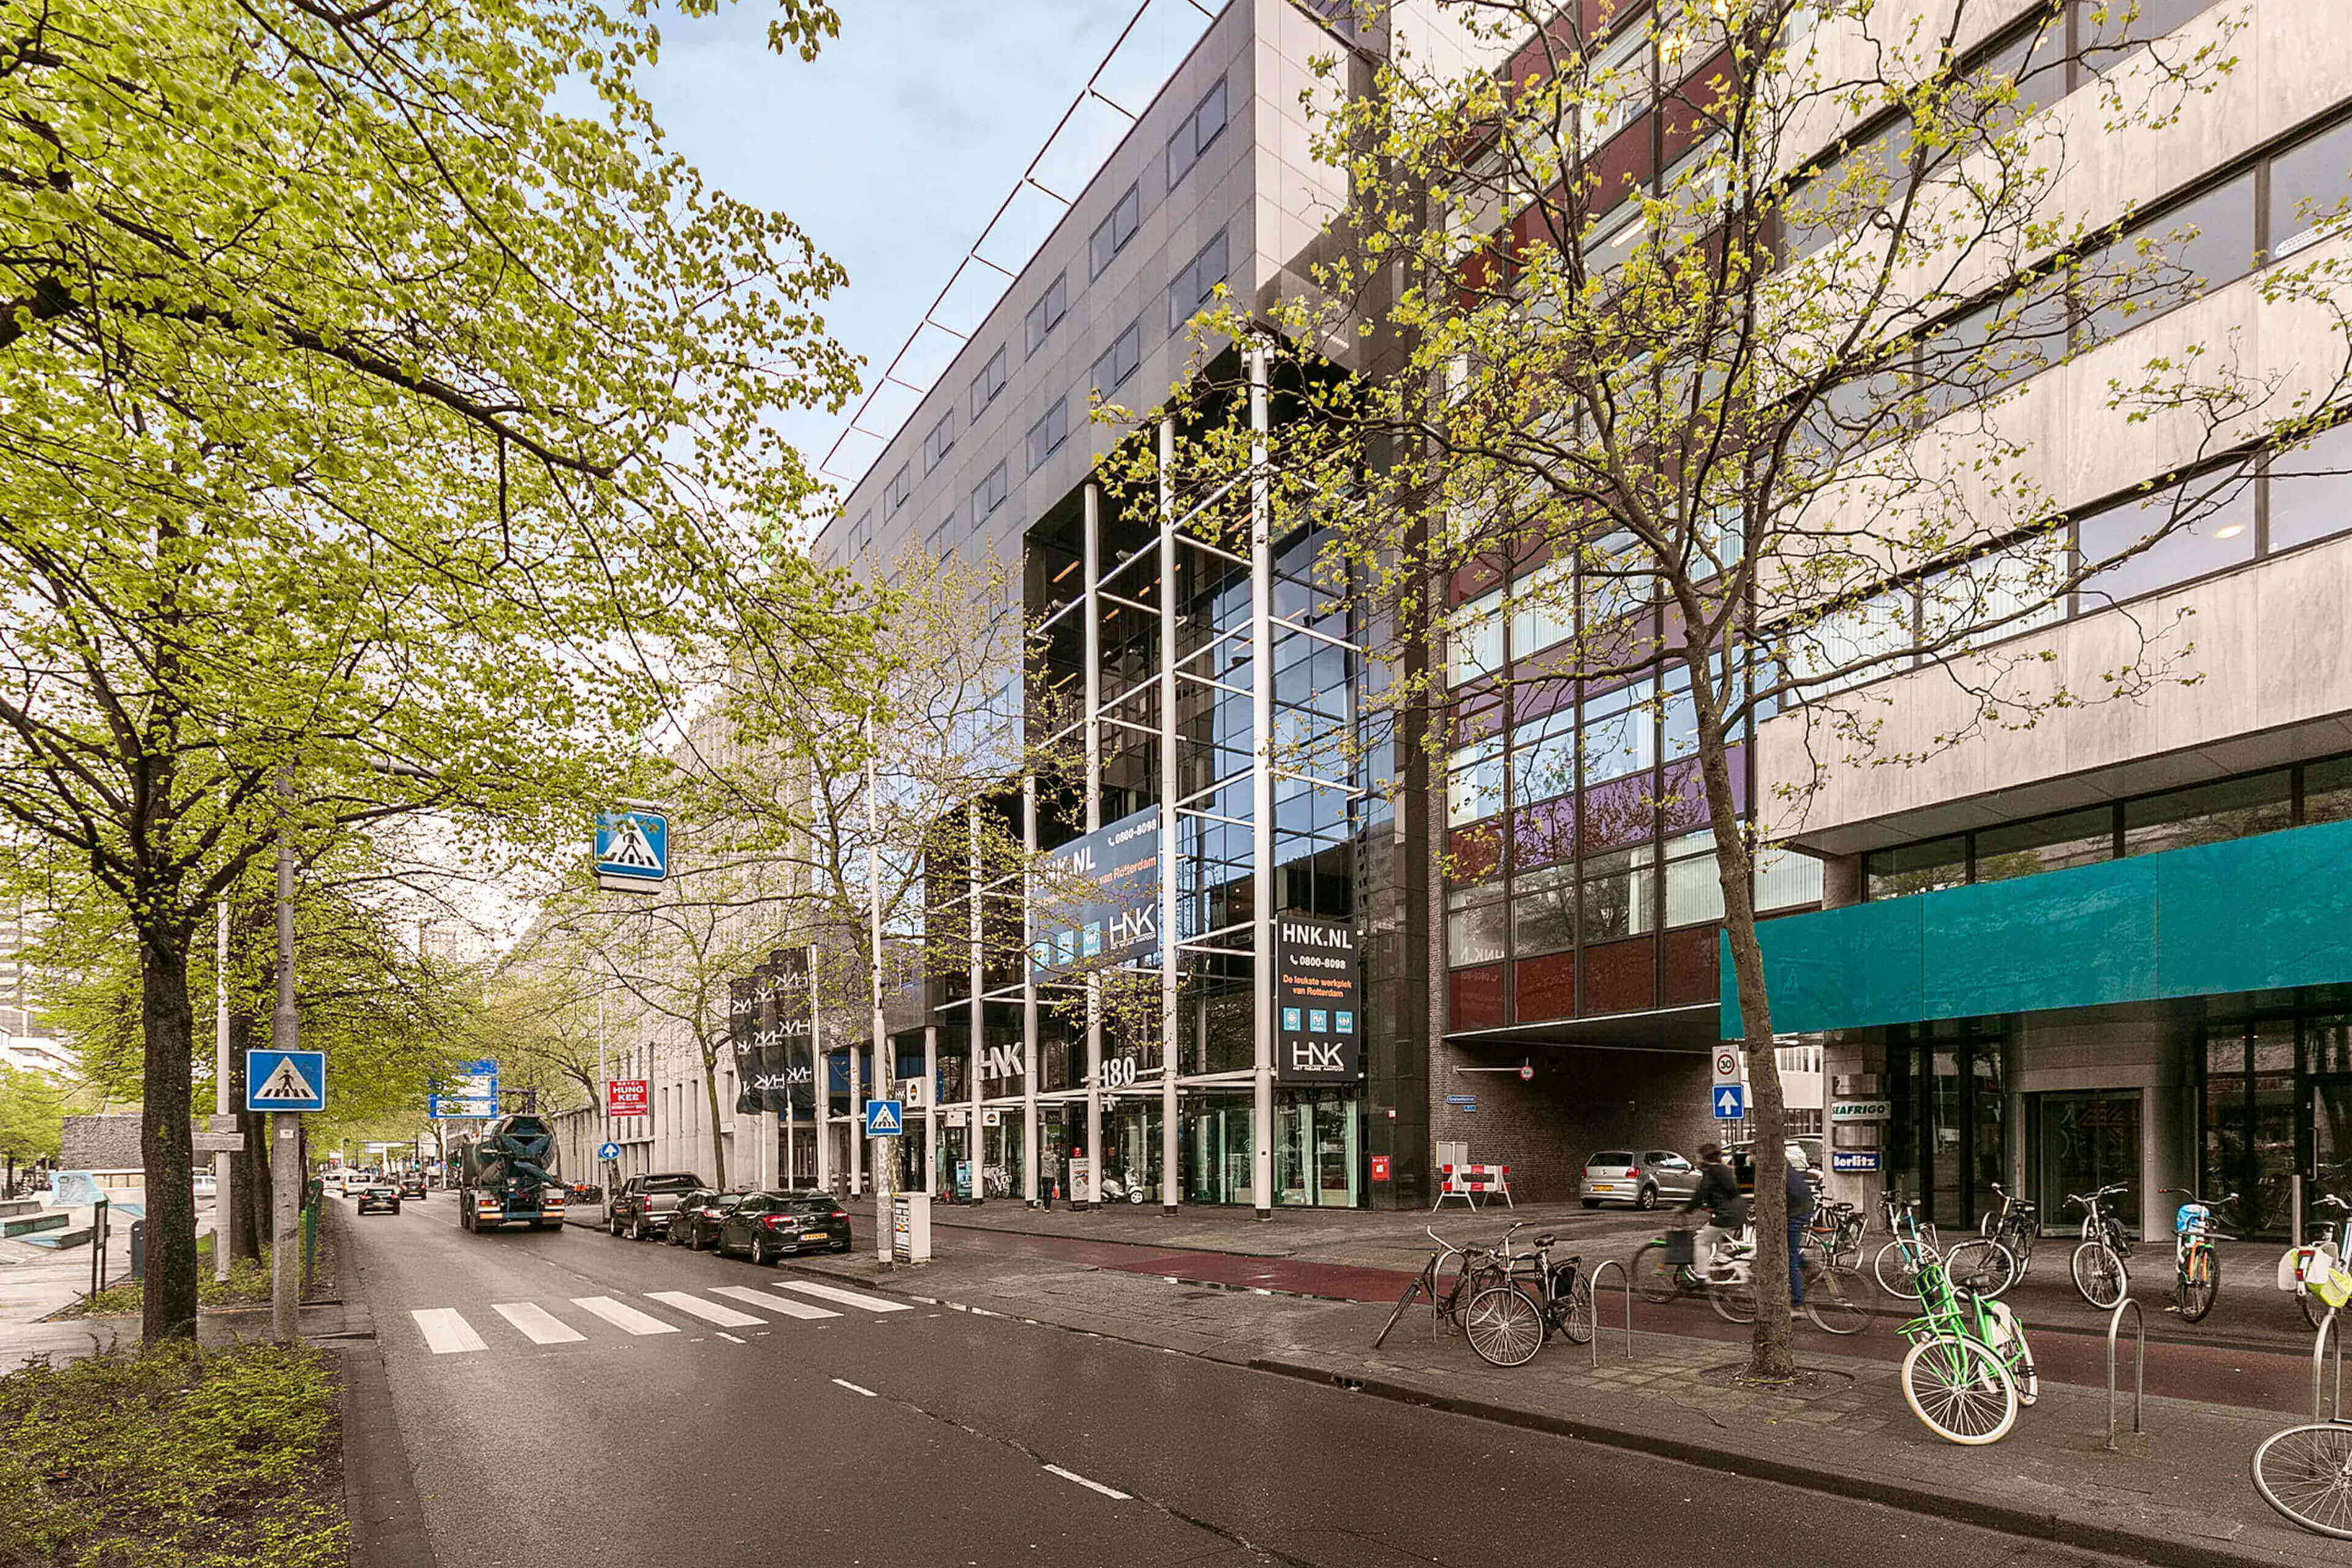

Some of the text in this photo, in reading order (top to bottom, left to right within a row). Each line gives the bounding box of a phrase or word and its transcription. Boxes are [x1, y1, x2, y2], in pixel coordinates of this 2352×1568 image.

[1114, 857, 1156, 880] Rotterdam
[1109, 903, 1156, 946] HNK
[1283, 923, 1353, 949] HNK.NL
[977, 1042, 1024, 1080] HNK
[1293, 1041, 1344, 1066] HNK
[1721, 1060, 1732, 1069] 30
[1101, 1057, 1136, 1088] 180
[1832, 1105, 1885, 1115] SEAFRIGO
[1833, 1155, 1875, 1167] Berlitz
